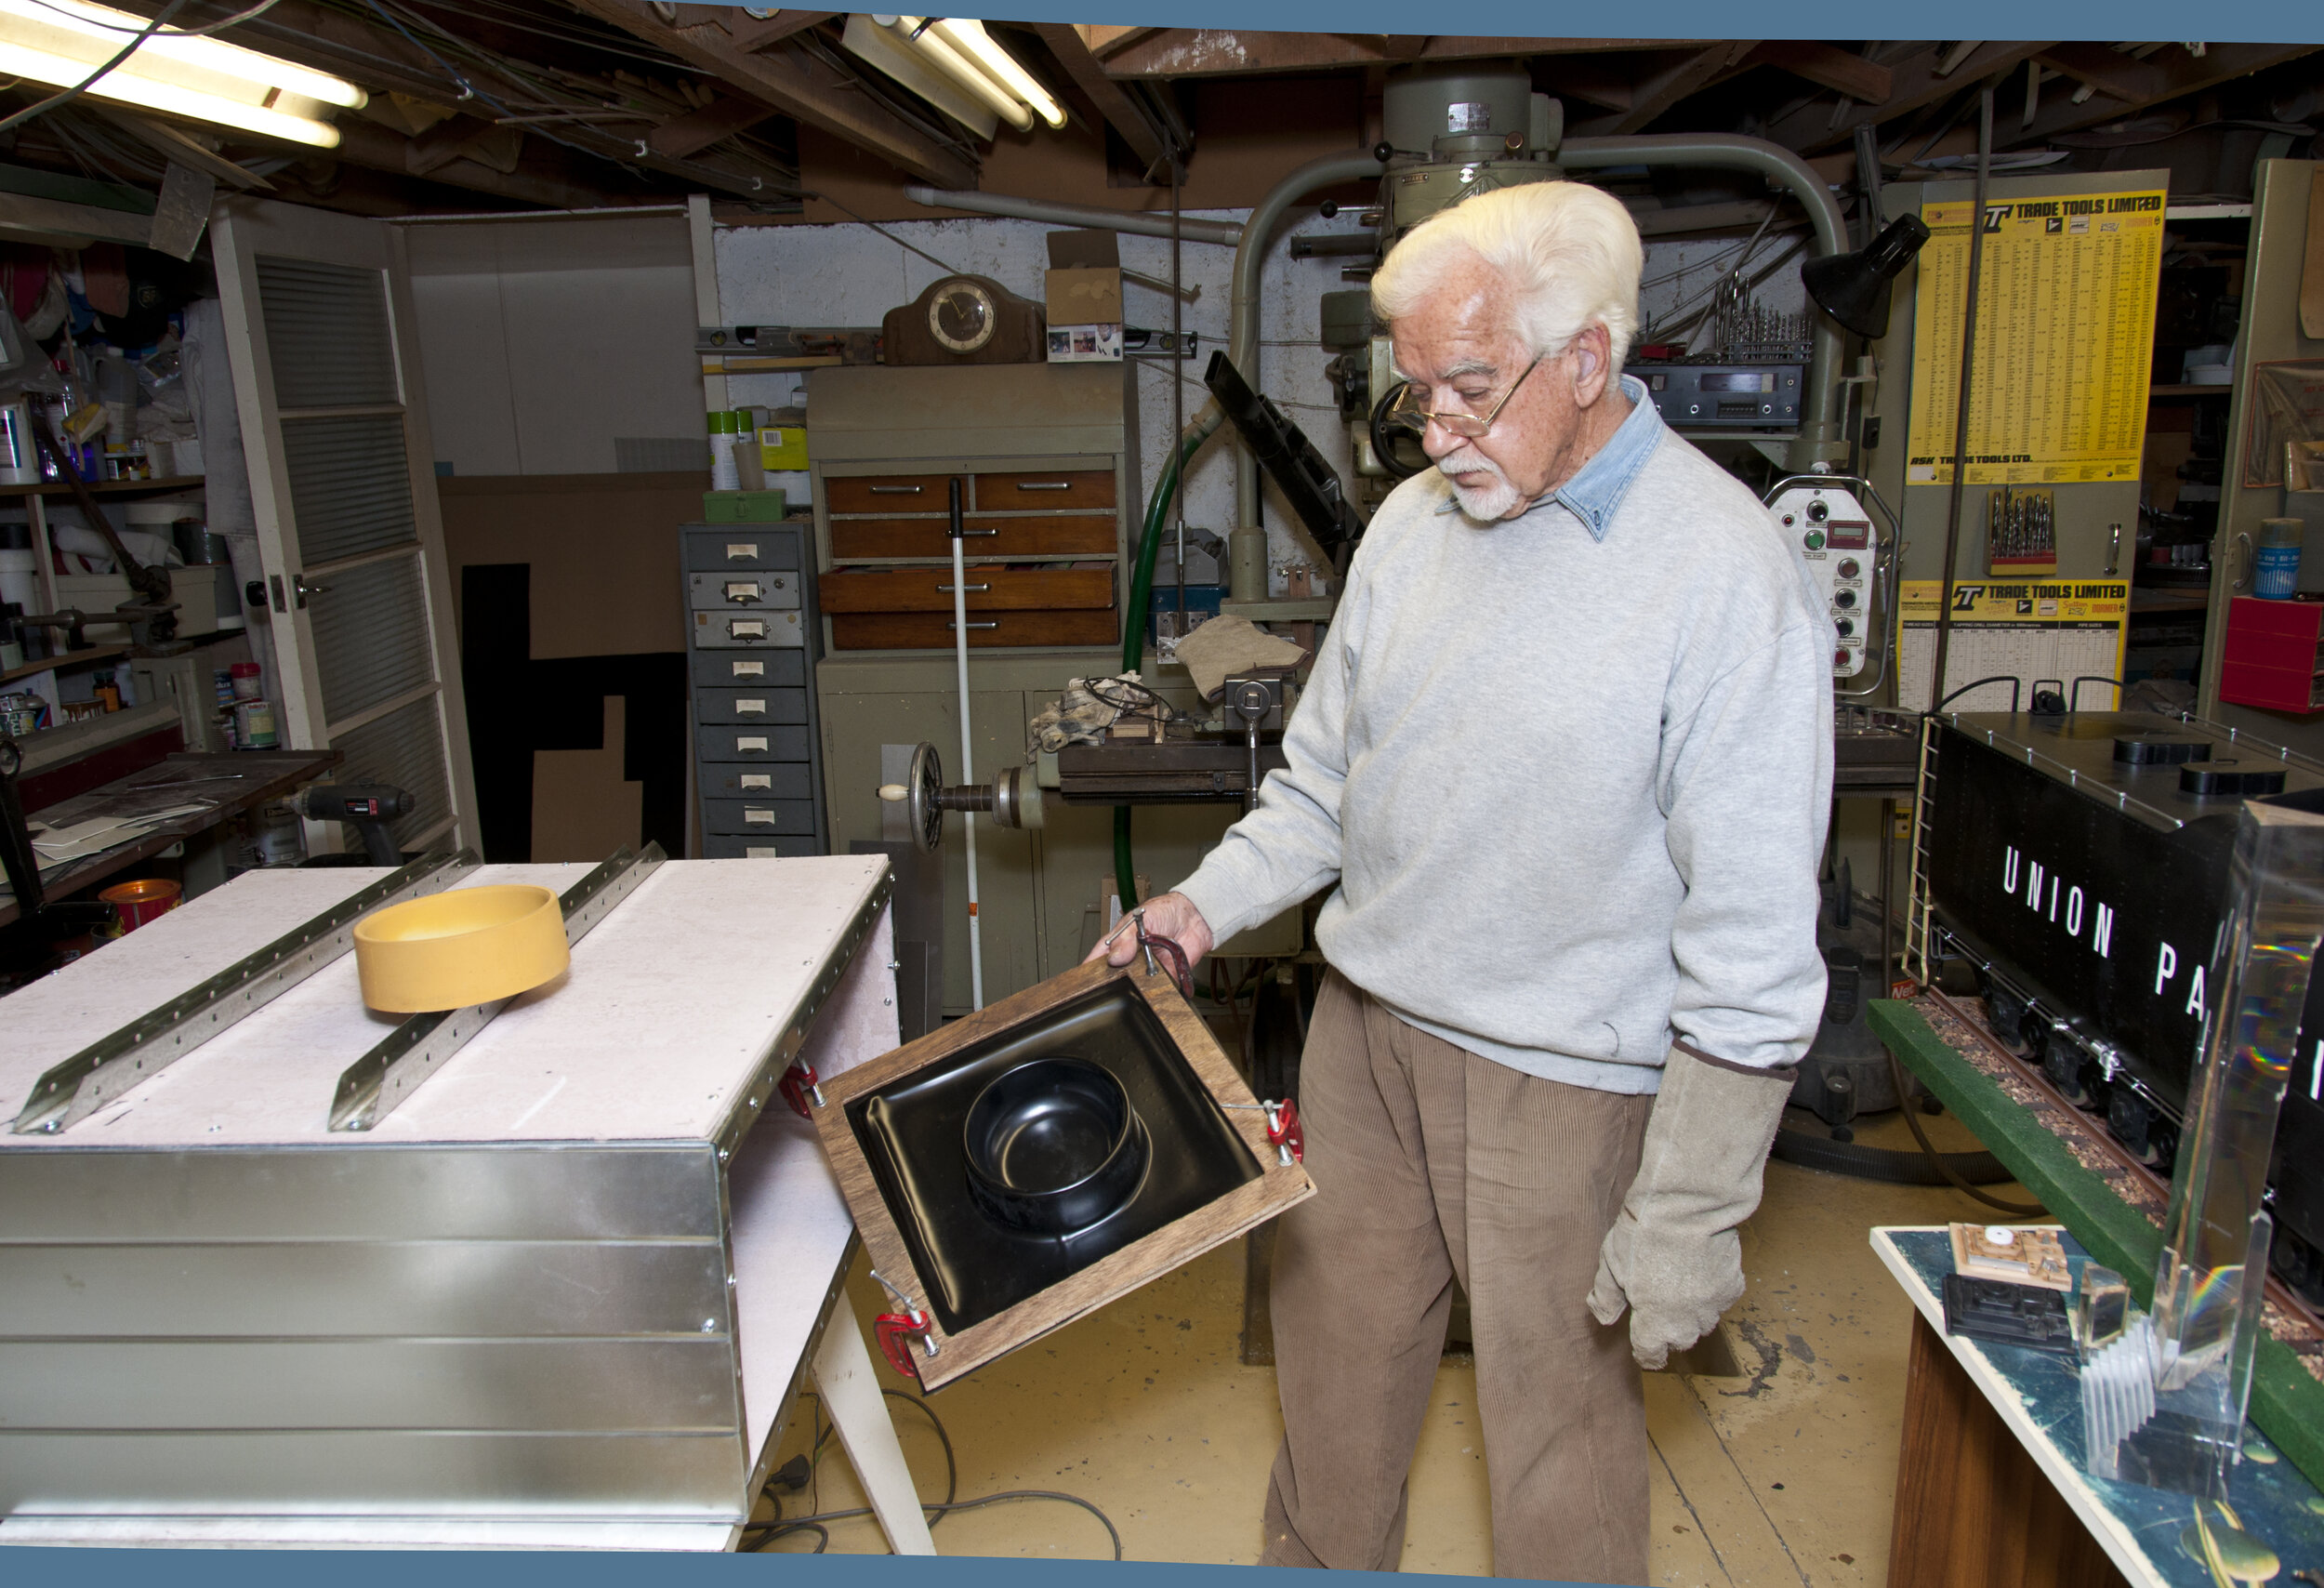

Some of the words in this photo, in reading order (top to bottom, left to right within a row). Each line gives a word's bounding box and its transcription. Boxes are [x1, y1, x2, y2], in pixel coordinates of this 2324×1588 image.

[2016, 202, 2059, 218] TRADE
[2062, 199, 2105, 216] TOOLS
[2107, 195, 2162, 213] LIMITED
[1910, 457, 1936, 465] ASK
[1975, 455, 2011, 464] TOOLS
[1988, 585, 2028, 599] TRADE
[2032, 585, 2072, 599] TOOLS
[2074, 585, 2126, 599] LIMITED
[2004, 845, 2113, 959] UNION
